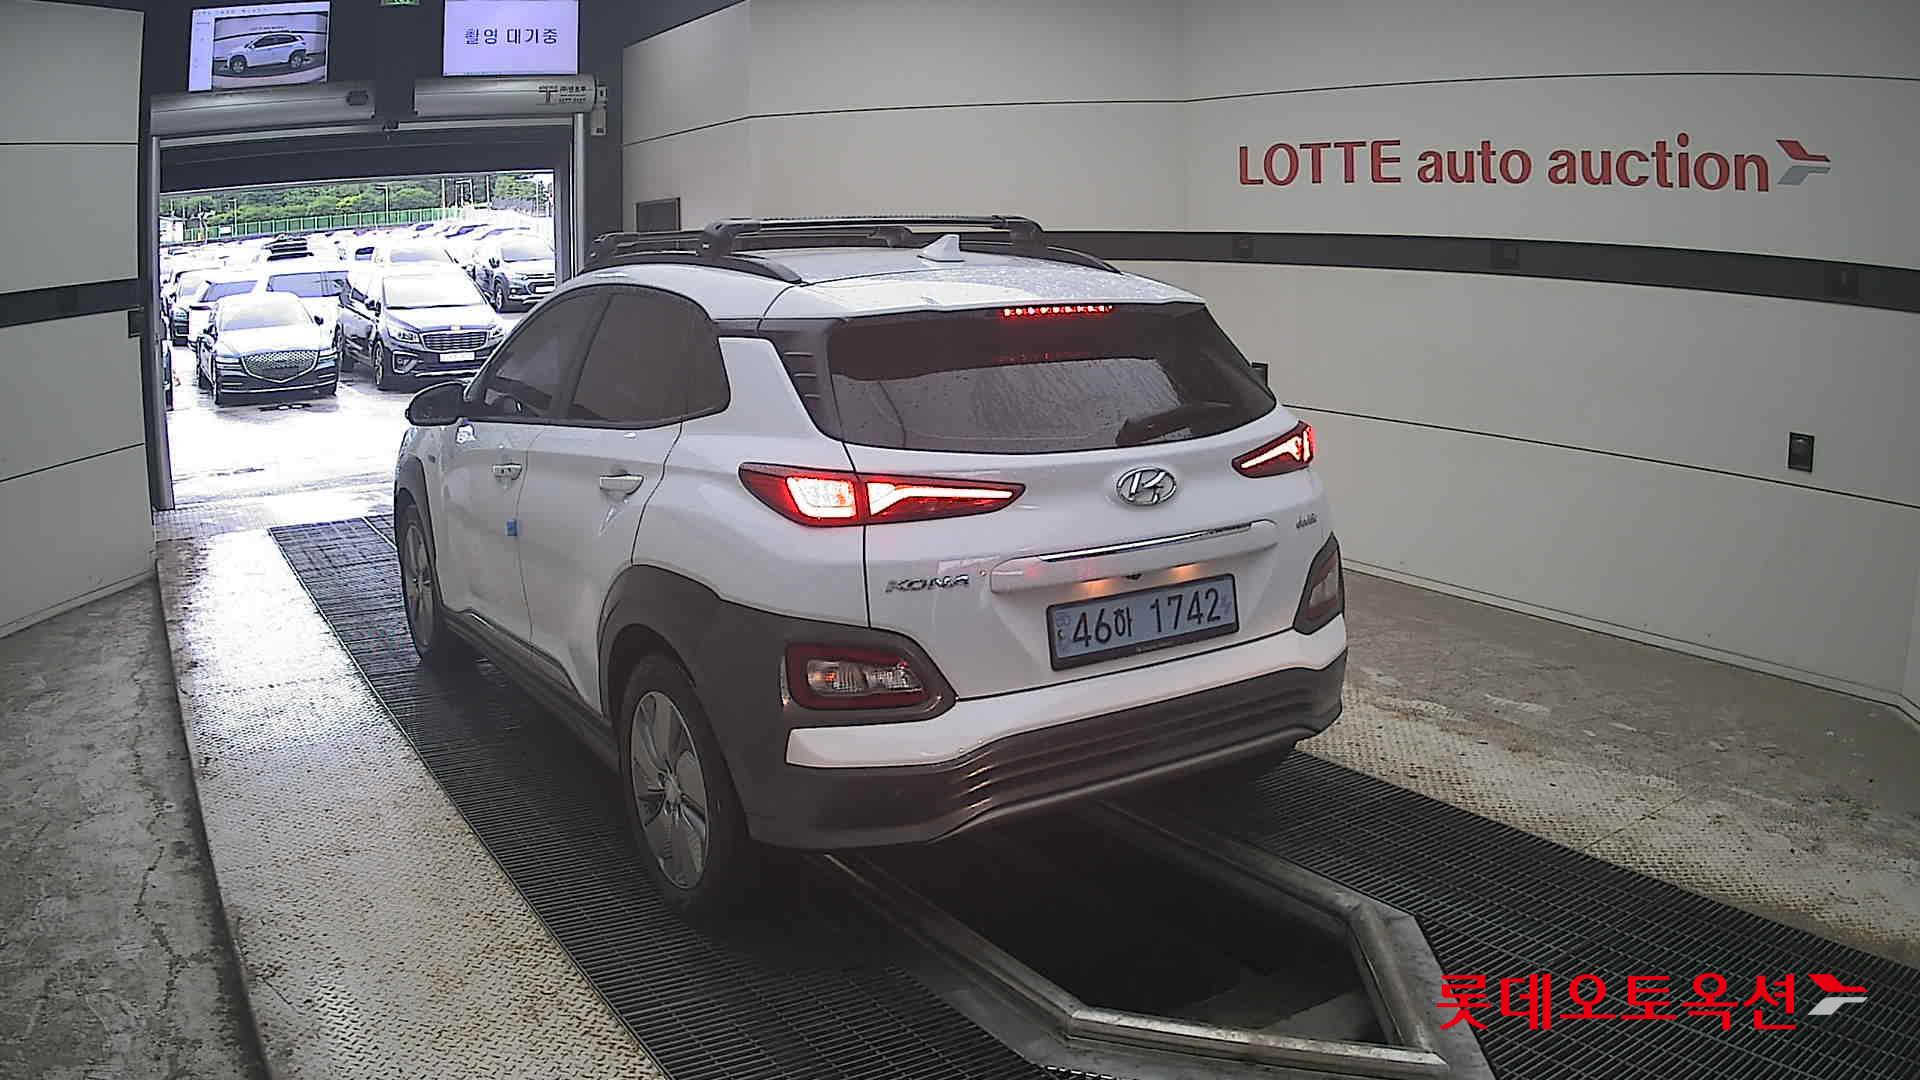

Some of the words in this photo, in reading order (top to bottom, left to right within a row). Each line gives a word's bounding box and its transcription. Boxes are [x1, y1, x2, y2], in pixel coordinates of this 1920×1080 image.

[506, 28, 557, 45] 대기중
[1239, 139, 1401, 186] LOTTE
[1417, 140, 1532, 185] auto
[1548, 133, 1768, 193] auction
[885, 574, 970, 593] KONA
[1072, 606, 1133, 648] 46하
[1150, 587, 1222, 632] 1742
